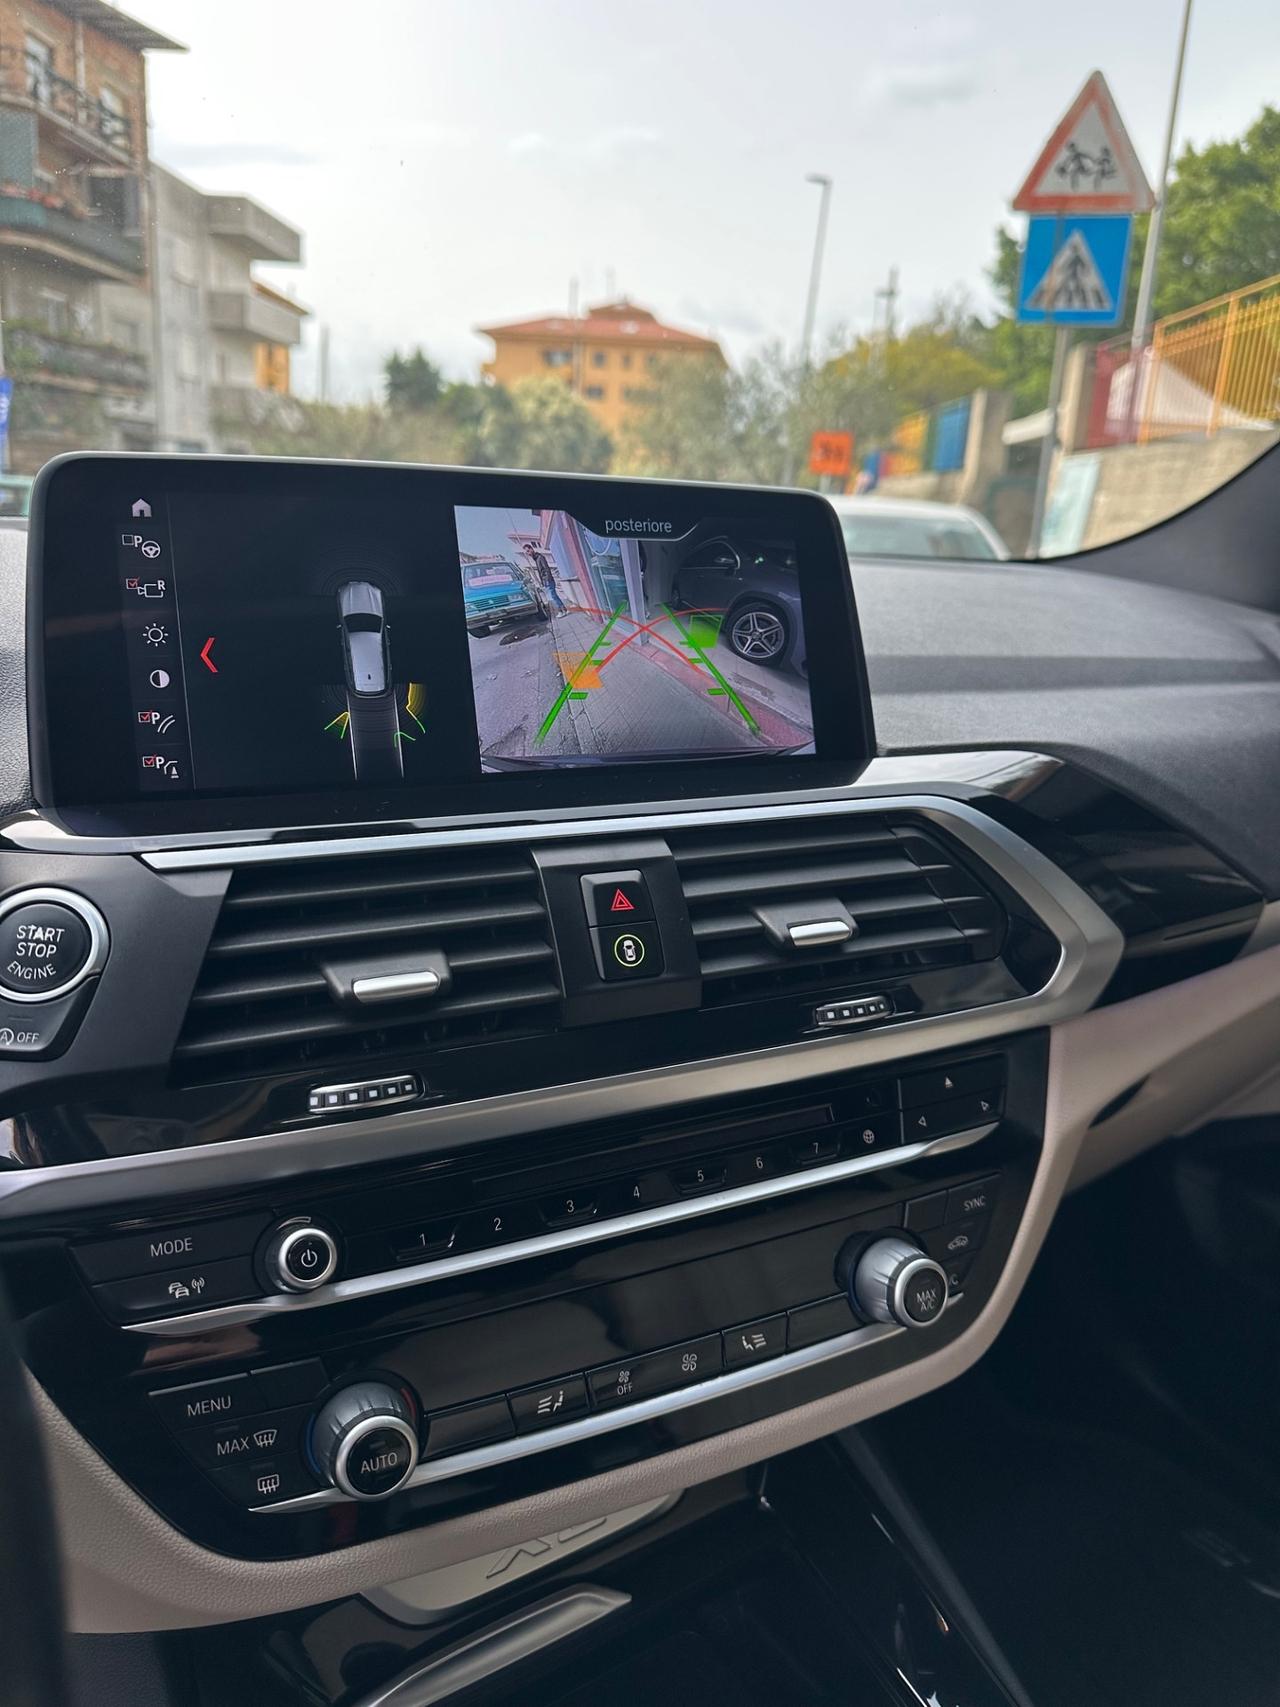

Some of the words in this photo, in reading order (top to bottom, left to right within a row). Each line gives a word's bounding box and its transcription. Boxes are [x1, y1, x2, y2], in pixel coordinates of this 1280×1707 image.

[605, 518, 673, 534] posteriore
[16, 925, 65, 943] START
[16, 942, 57, 958] STOP
[7, 960, 57, 979] ENGINE
[17, 1031, 40, 1043] OFF
[419, 1233, 426, 1247] 1
[493, 1217, 502, 1232] 2
[566, 1200, 575, 1213] 3
[633, 1185, 641, 1198] 4
[697, 1169, 705, 1183] 5
[755, 1156, 764, 1169] 6
[813, 1142, 820, 1154] 7
[964, 1196, 987, 1212] SYNC
[150, 1237, 193, 1257] MODE
[916, 1288, 938, 1304] MAX
[920, 1300, 935, 1313] A/C
[616, 1382, 634, 1396] OFF
[187, 1395, 232, 1417] MENU
[216, 1437, 250, 1456] MAX
[360, 1452, 398, 1474] AUTO
